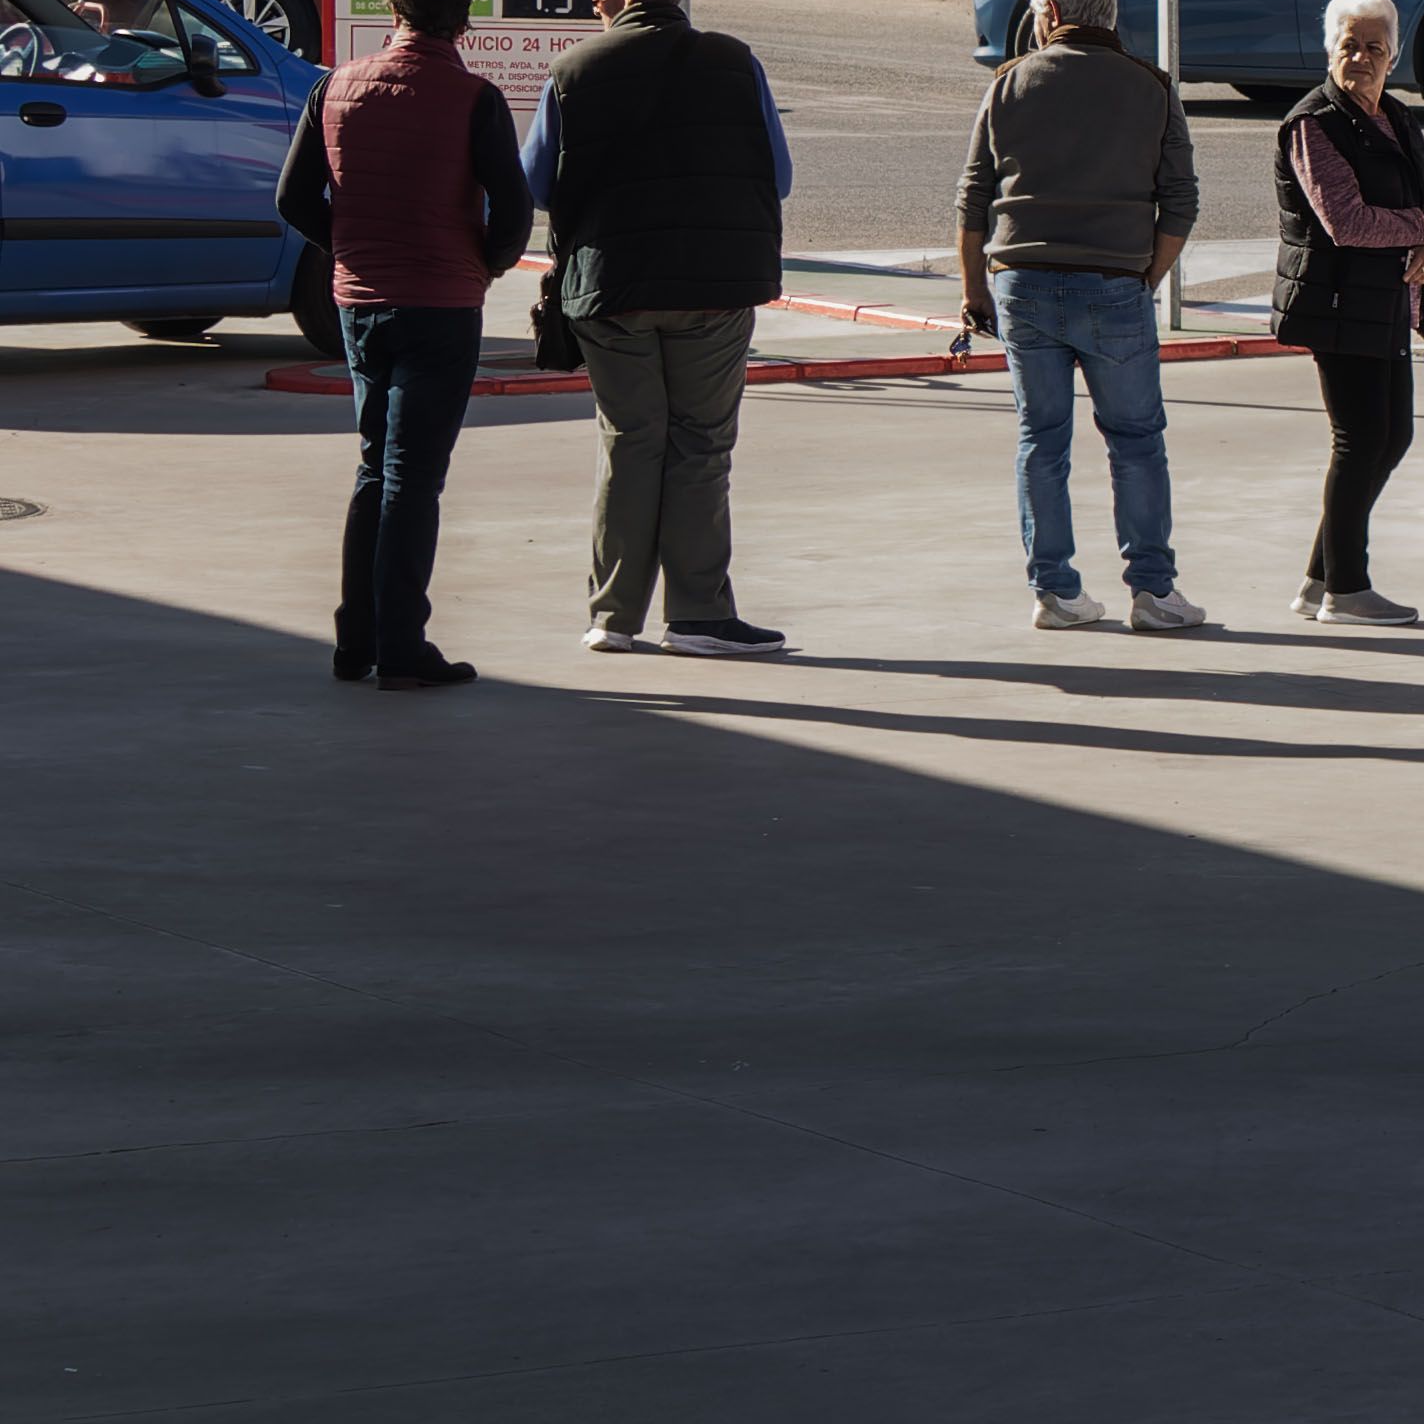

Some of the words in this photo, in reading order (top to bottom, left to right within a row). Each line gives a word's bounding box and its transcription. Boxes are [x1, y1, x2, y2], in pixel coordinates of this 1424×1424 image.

[522, 37, 541, 52] 24
[538, 62, 550, 70] RA
[508, 73, 549, 81] DISPOSIC
